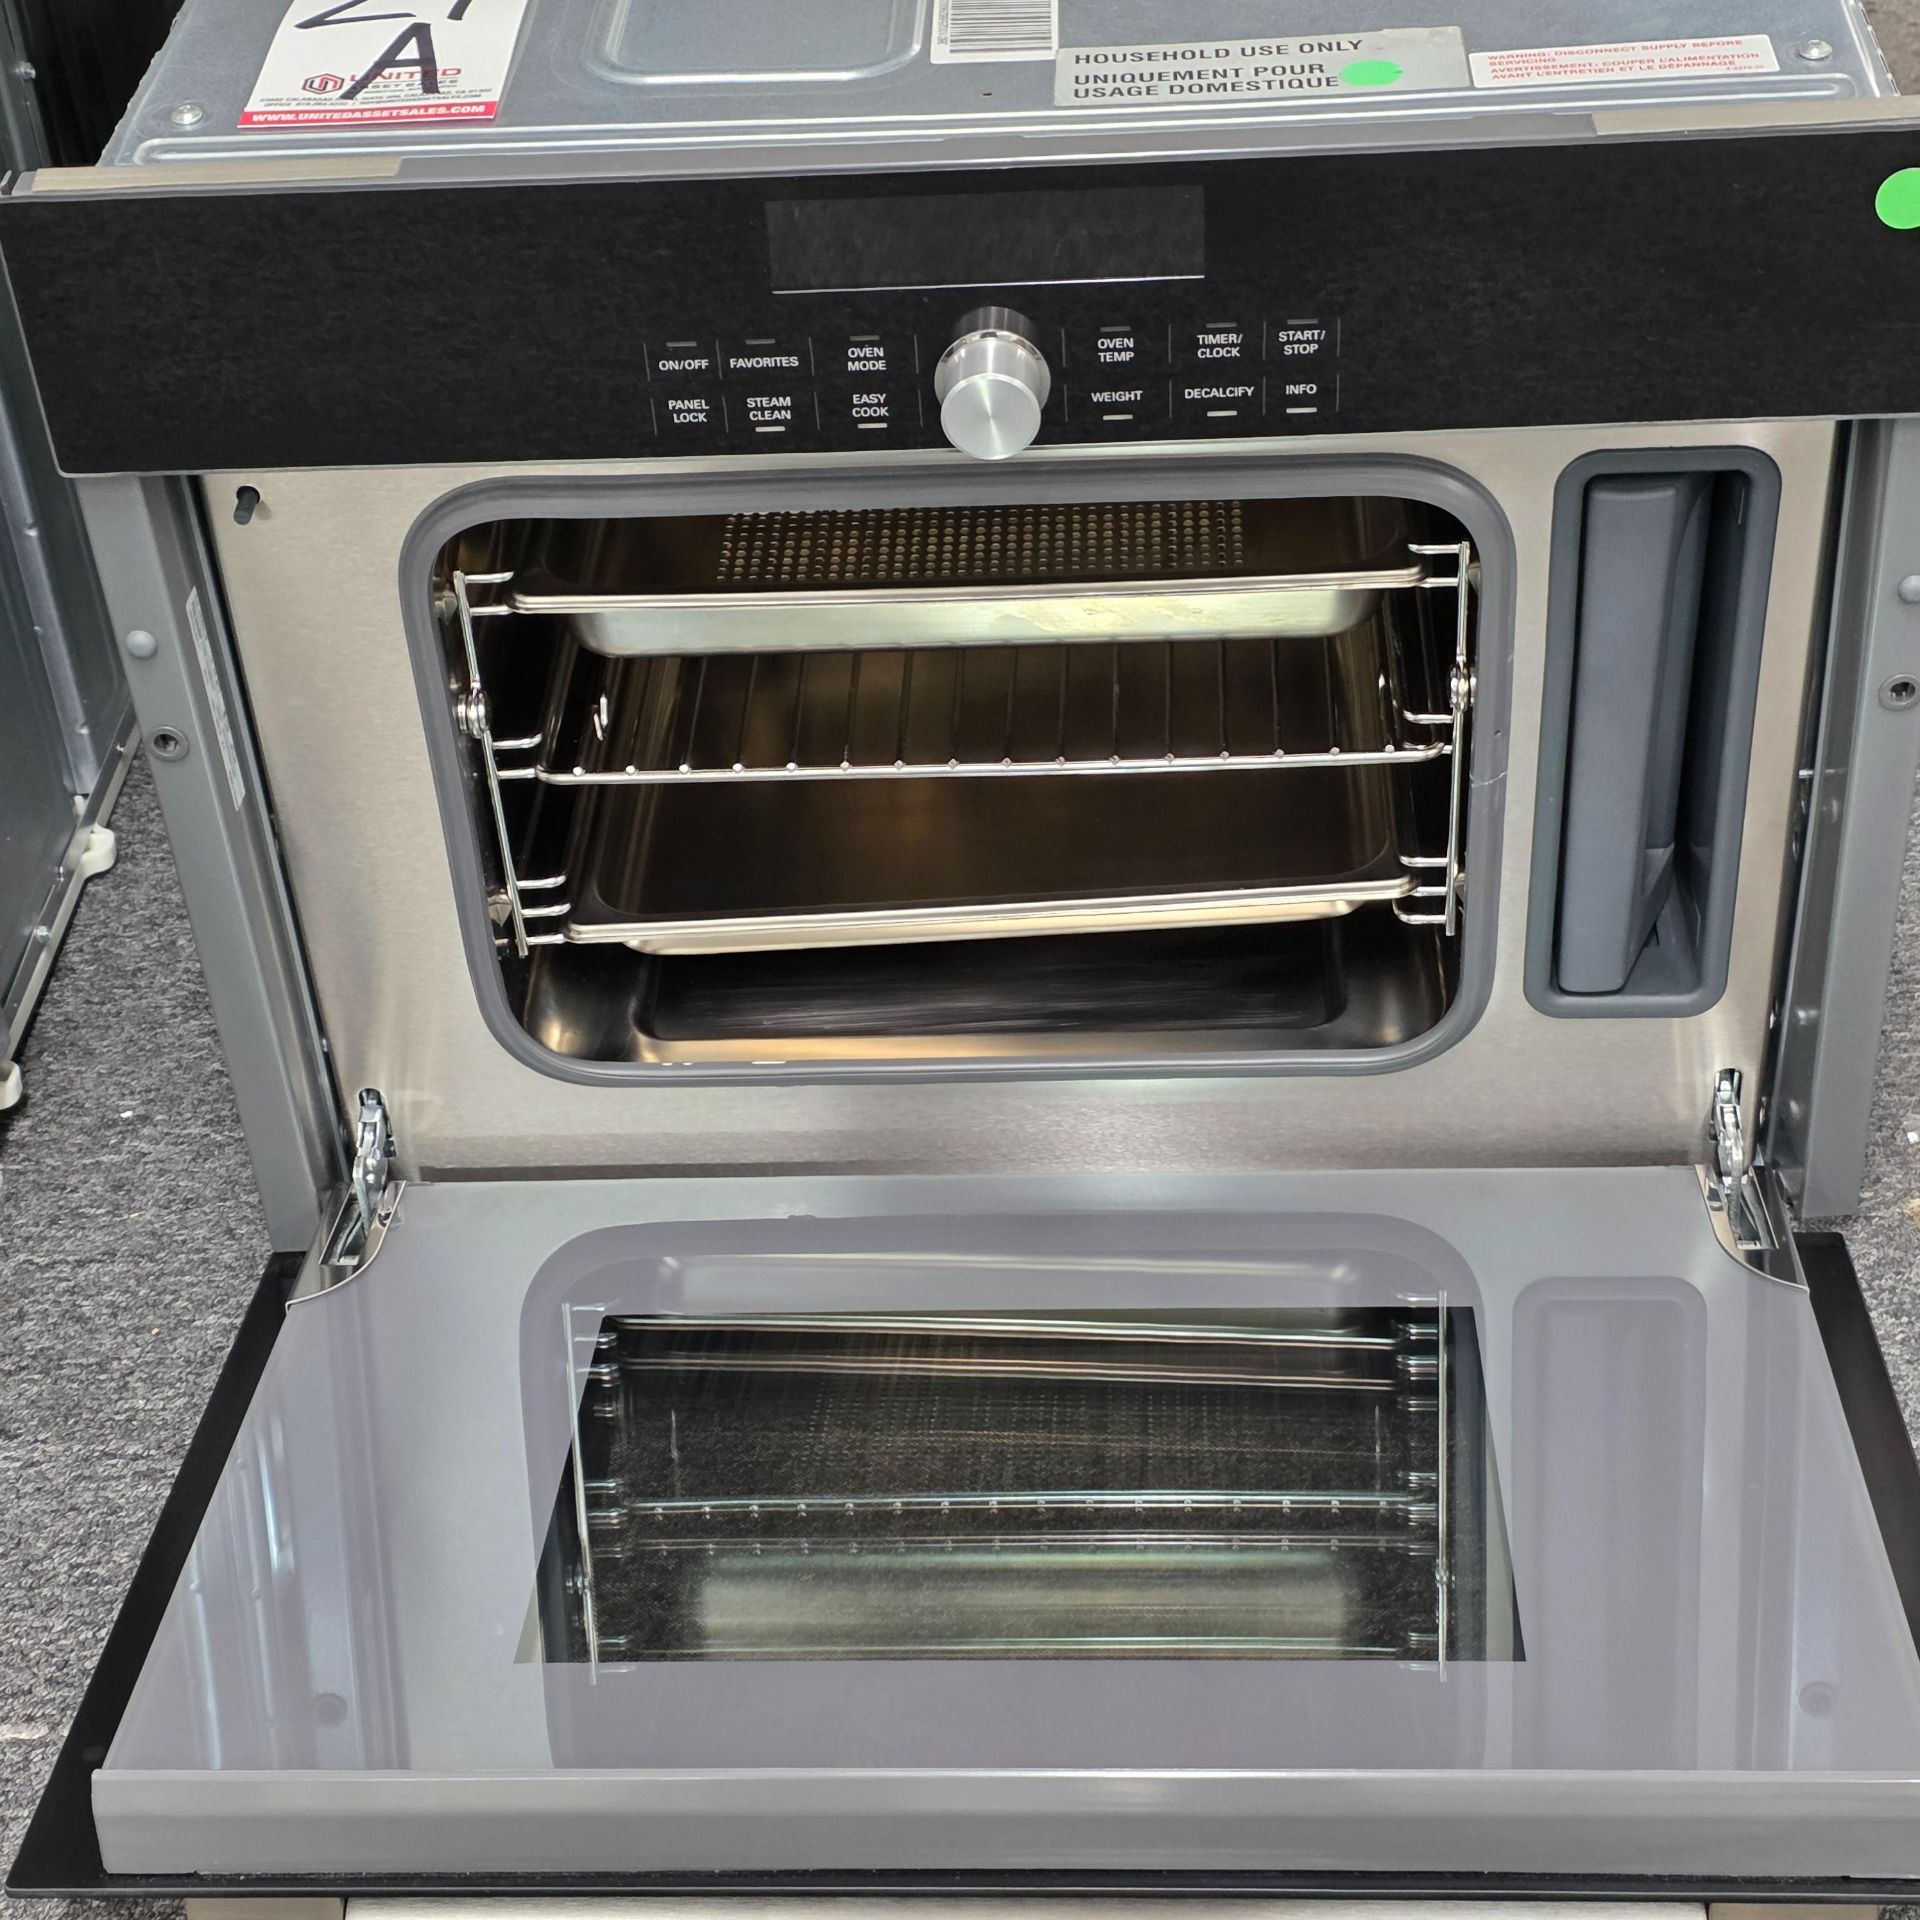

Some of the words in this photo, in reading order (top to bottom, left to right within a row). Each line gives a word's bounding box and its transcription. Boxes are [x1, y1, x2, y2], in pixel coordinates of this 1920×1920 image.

[1074, 48, 1230, 64] HOUSEHOLD
[1240, 44, 1289, 58] USE
[1299, 39, 1363, 54] ONLY
[1554, 45, 1637, 56] DISCONNECT
[1641, 42, 1687, 50] SUPPLY
[1692, 40, 1743, 48] BEFORE
[340, 22, 441, 100] A
[350, 67, 462, 82] UNITD
[1074, 67, 1245, 85] UNIQUEMENT
[1253, 63, 1325, 77] POUR
[1491, 72, 1532, 80] AVANT
[1073, 85, 1158, 98] USAGE
[1169, 76, 1340, 95] DOMESTIQUE
[252, 104, 486, 121] WWW.UNITEDASSETSALES.COM
[1197, 333, 1243, 345] TIMER/
[1278, 330, 1326, 342] START/
[1097, 338, 1134, 349] OVEN
[1283, 343, 1318, 355] STOP
[847, 347, 884, 358] OVEN
[1097, 351, 1134, 362] TEMP
[1197, 347, 1240, 358] CLOCK
[658, 359, 709, 371] ON/OFF
[729, 356, 799, 369] FAVORITES
[847, 360, 887, 371] MODE
[1184, 386, 1255, 399] DECALCIFY
[1285, 383, 1317, 395] INFO
[746, 396, 791, 408] STEAM
[852, 393, 887, 405] EASY
[1091, 390, 1143, 402] WEIGHT
[668, 399, 709, 410] PANEL
[673, 412, 707, 423] LOCK
[749, 410, 791, 421] CLEAN
[852, 406, 889, 418] COOK
